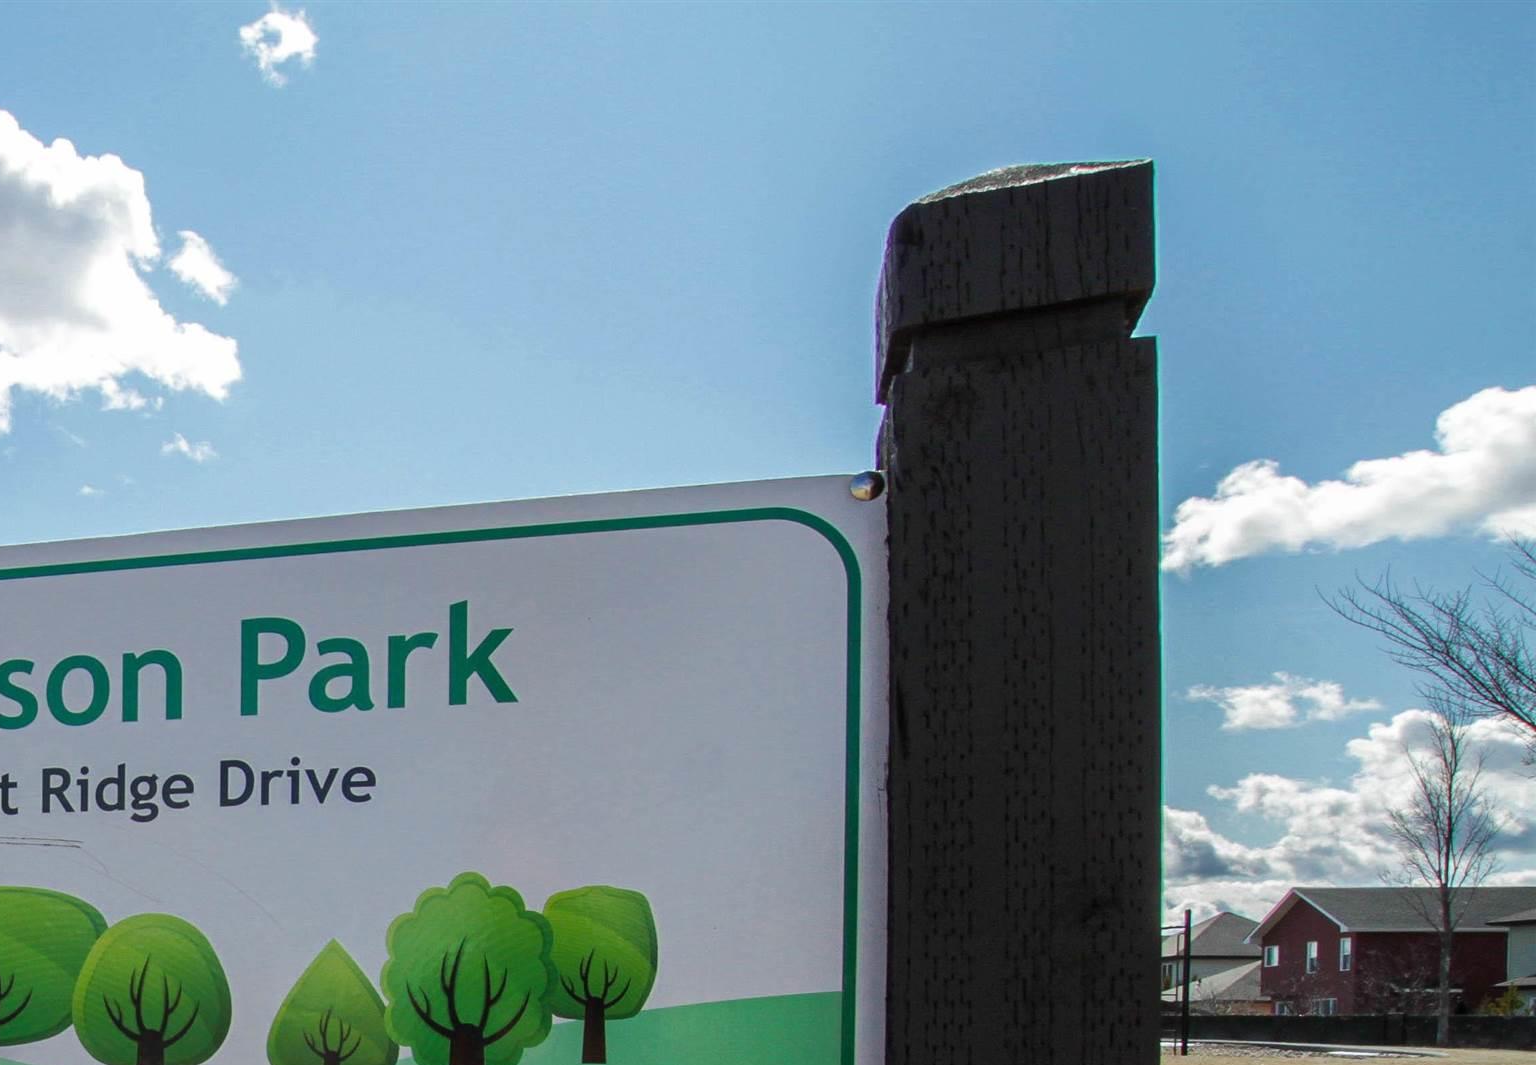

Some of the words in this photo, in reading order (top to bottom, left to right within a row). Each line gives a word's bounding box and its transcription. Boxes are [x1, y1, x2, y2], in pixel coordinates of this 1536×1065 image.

[240, 600, 518, 716] Park
[41, 763, 195, 824] Ridge
[218, 757, 378, 808] Drive
